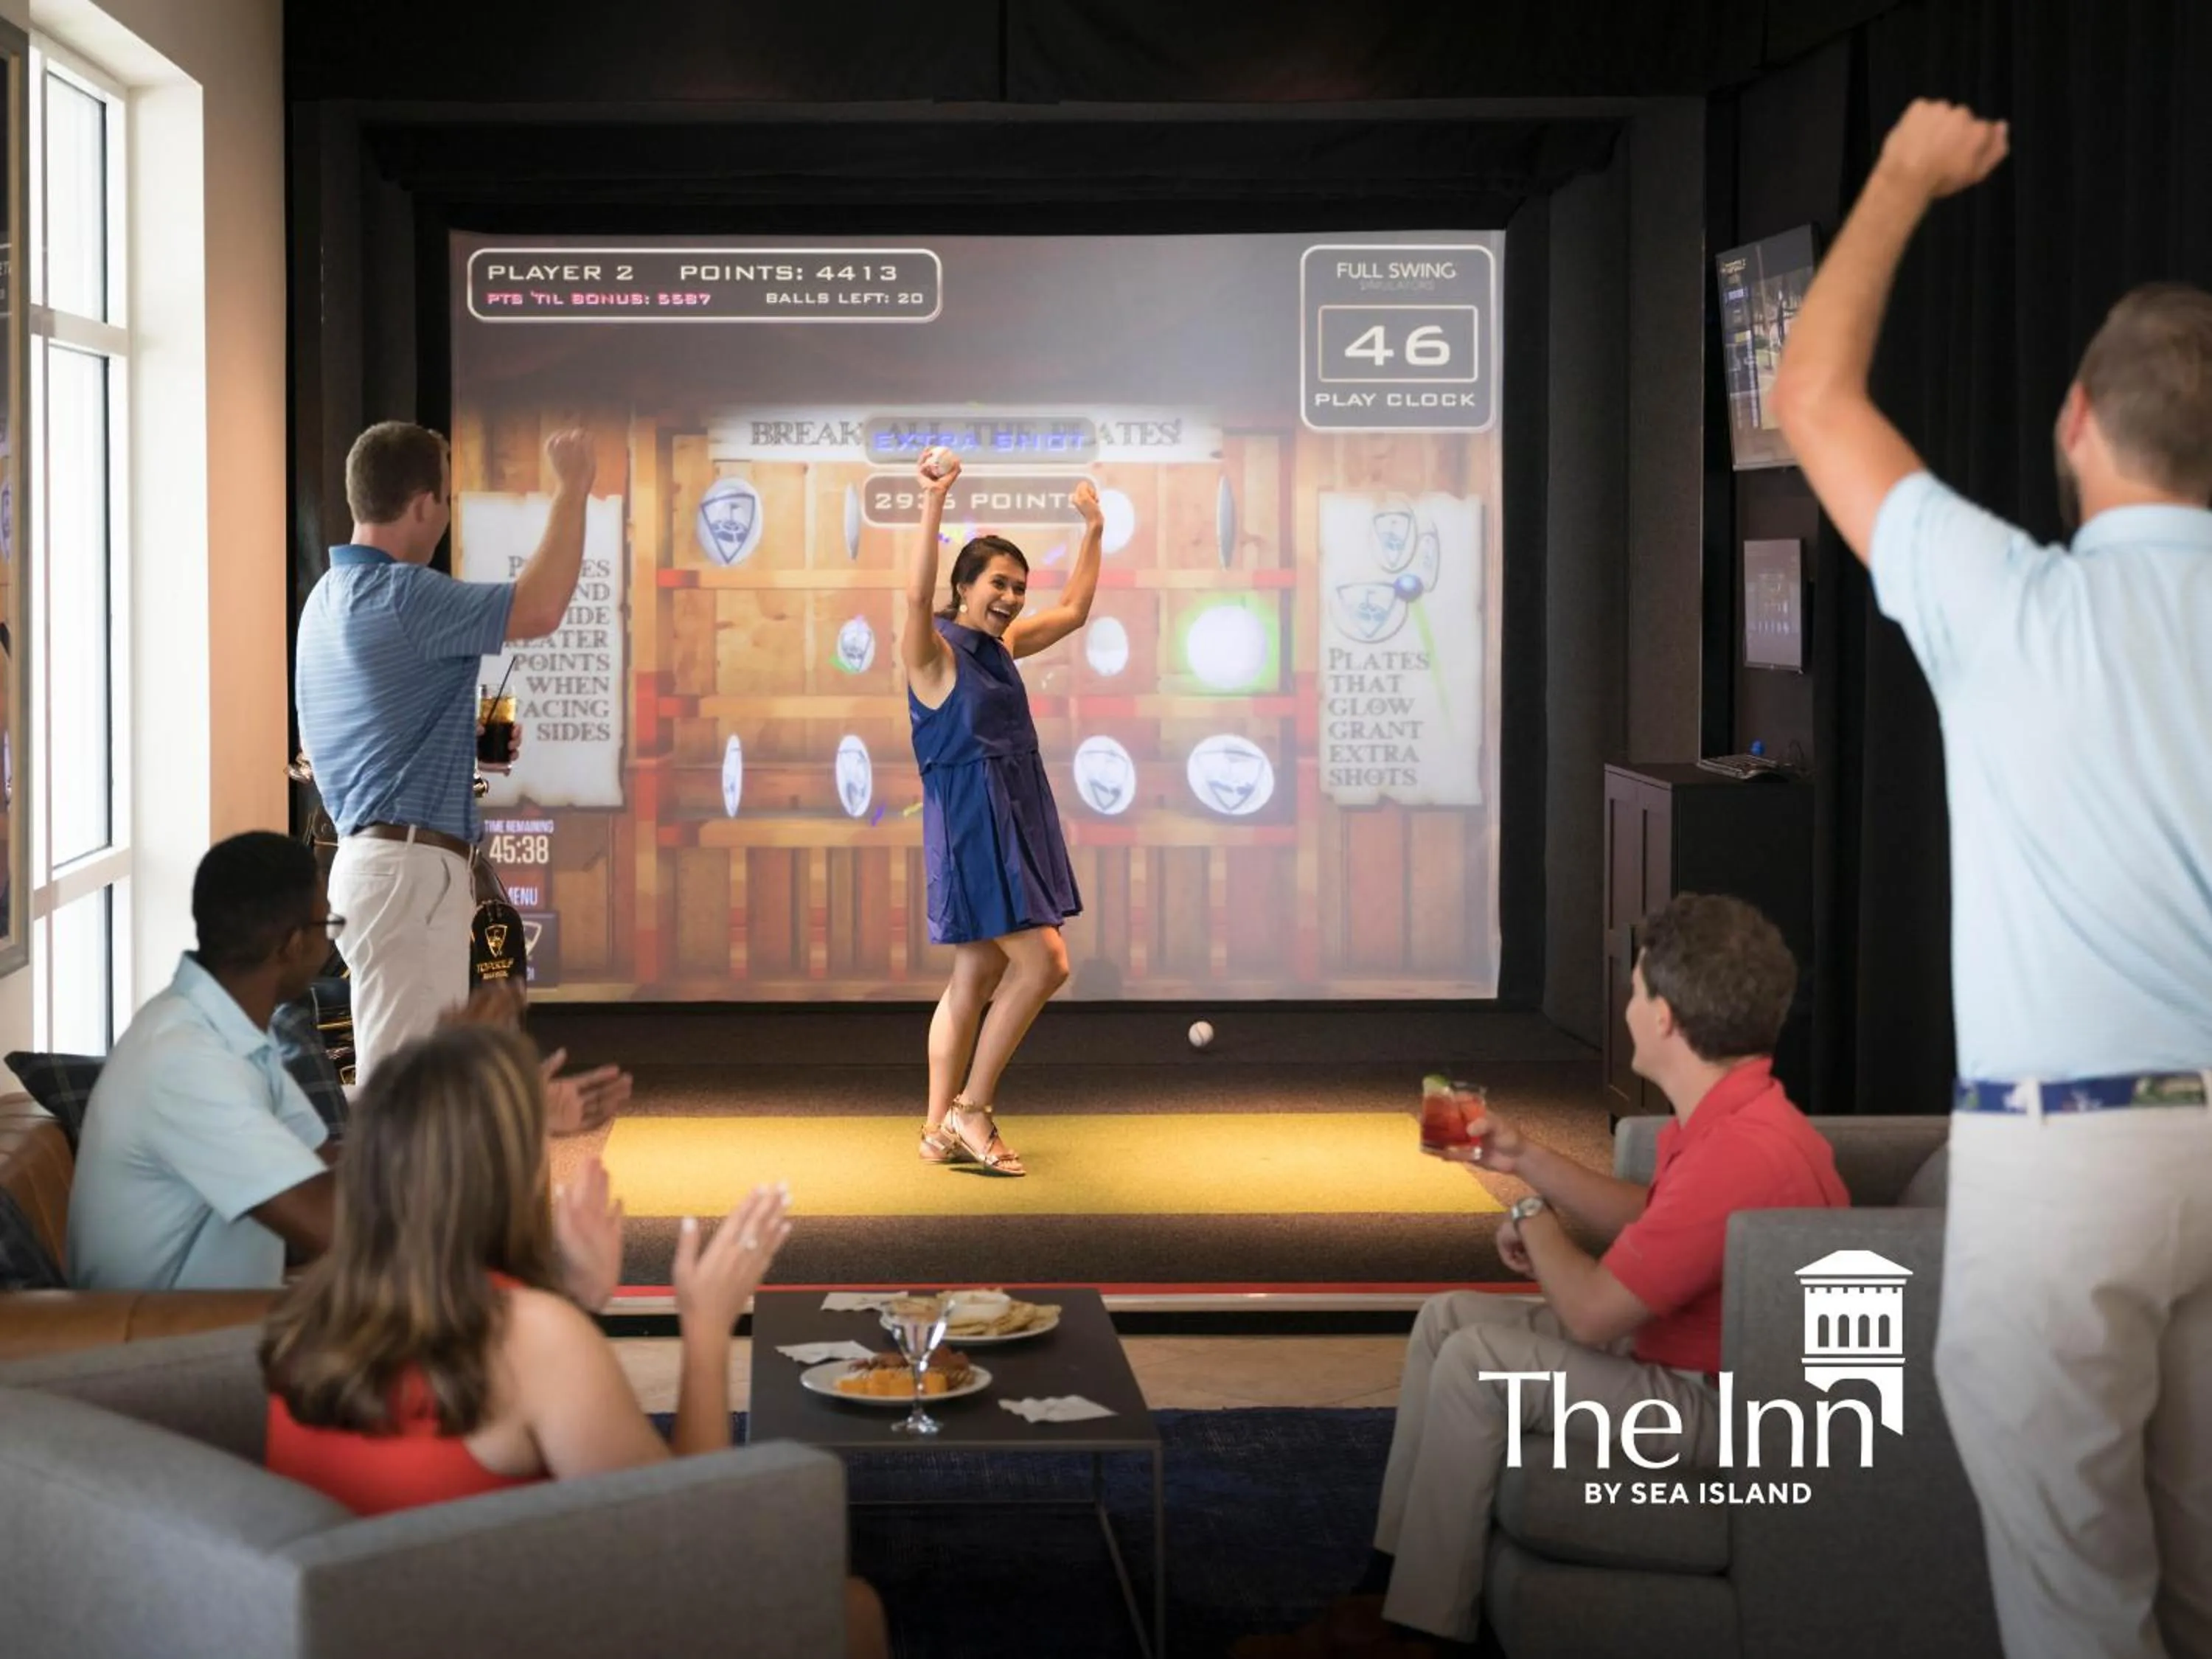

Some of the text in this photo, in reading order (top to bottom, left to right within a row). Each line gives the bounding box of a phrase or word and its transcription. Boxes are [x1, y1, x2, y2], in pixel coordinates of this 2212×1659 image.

[487, 265, 897, 281] PLAYER 2 POINTS: 4413
[1337, 262, 1457, 279] FULL SWING
[487, 293, 523, 305] PTS
[571, 293, 650, 305] BONUS:
[658, 293, 711, 305] 5587
[766, 293, 923, 305] BALLS LEFT: 20
[1344, 325, 1450, 366] 46
[1315, 393, 1475, 406] PLAY CLOCK
[751, 421, 864, 445] BREAK
[508, 555, 610, 578] PES
[512, 653, 610, 672] POINTS
[1328, 647, 1430, 671] PLATES
[526, 676, 610, 695] WHEN
[1328, 675, 1404, 693] THAT
[1328, 698, 1416, 717] GLOW
[536, 723, 610, 742] SIDES
[1328, 721, 1424, 740] GRANT
[1328, 745, 1420, 764] EXTRA
[1328, 768, 1419, 787] SHOTS
[484, 820, 554, 833] TIME REMAINING
[489, 835, 549, 863] 45:38
